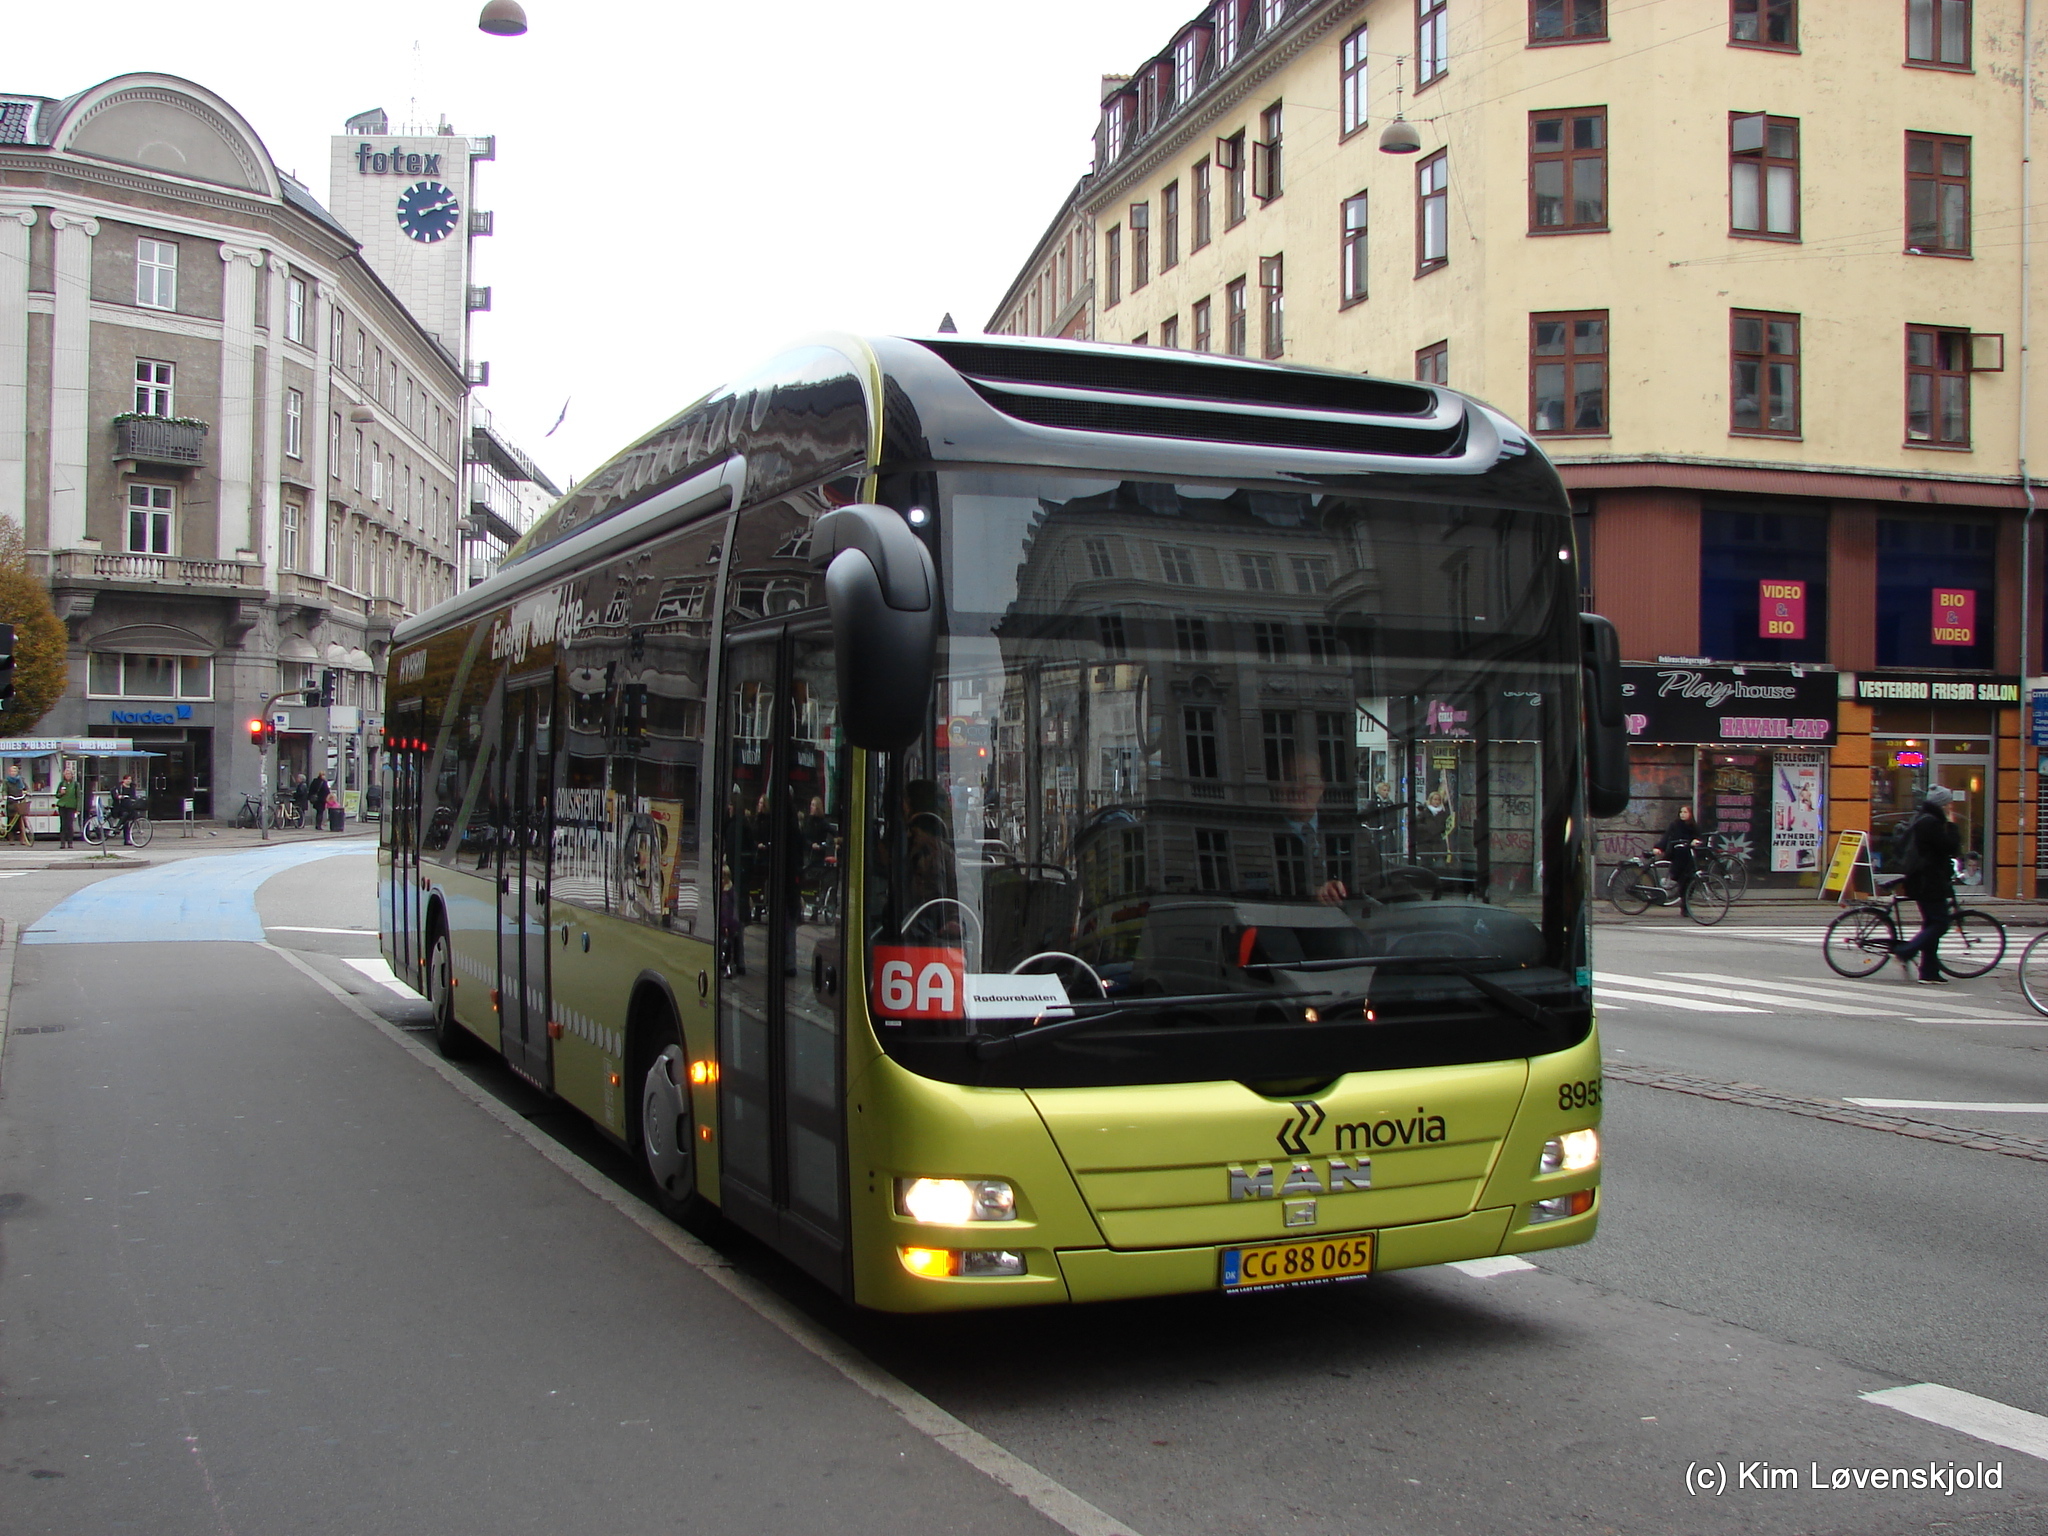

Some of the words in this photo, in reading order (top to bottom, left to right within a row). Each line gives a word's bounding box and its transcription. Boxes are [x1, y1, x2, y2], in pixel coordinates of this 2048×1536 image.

[1762, 585, 1801, 599] VIDEO
[1940, 594, 1965, 607] BIO
[1775, 603, 1788, 617] &
[1946, 611, 1958, 624] &
[491, 619, 531, 665] Energy
[531, 597, 584, 650] Storage
[1768, 621, 1795, 634] BIO
[1934, 628, 1970, 641] VIDEO
[1858, 681, 1928, 699] VESTERBRO
[1932, 683, 1975, 701] FRISØR
[1977, 684, 2018, 701] SALON
[111, 710, 175, 724] Nordea
[1720, 716, 1829, 739] HAWAII-ZAP
[881, 960, 954, 1012] 6A
[1335, 1107, 1446, 1151] movia
[1227, 1155, 1372, 1200] MAN
[1242, 1251, 1278, 1278] CG
[1283, 1246, 1315, 1274] 88
[1321, 1241, 1367, 1269] 065
[1225, 1271, 1236, 1280] DK
